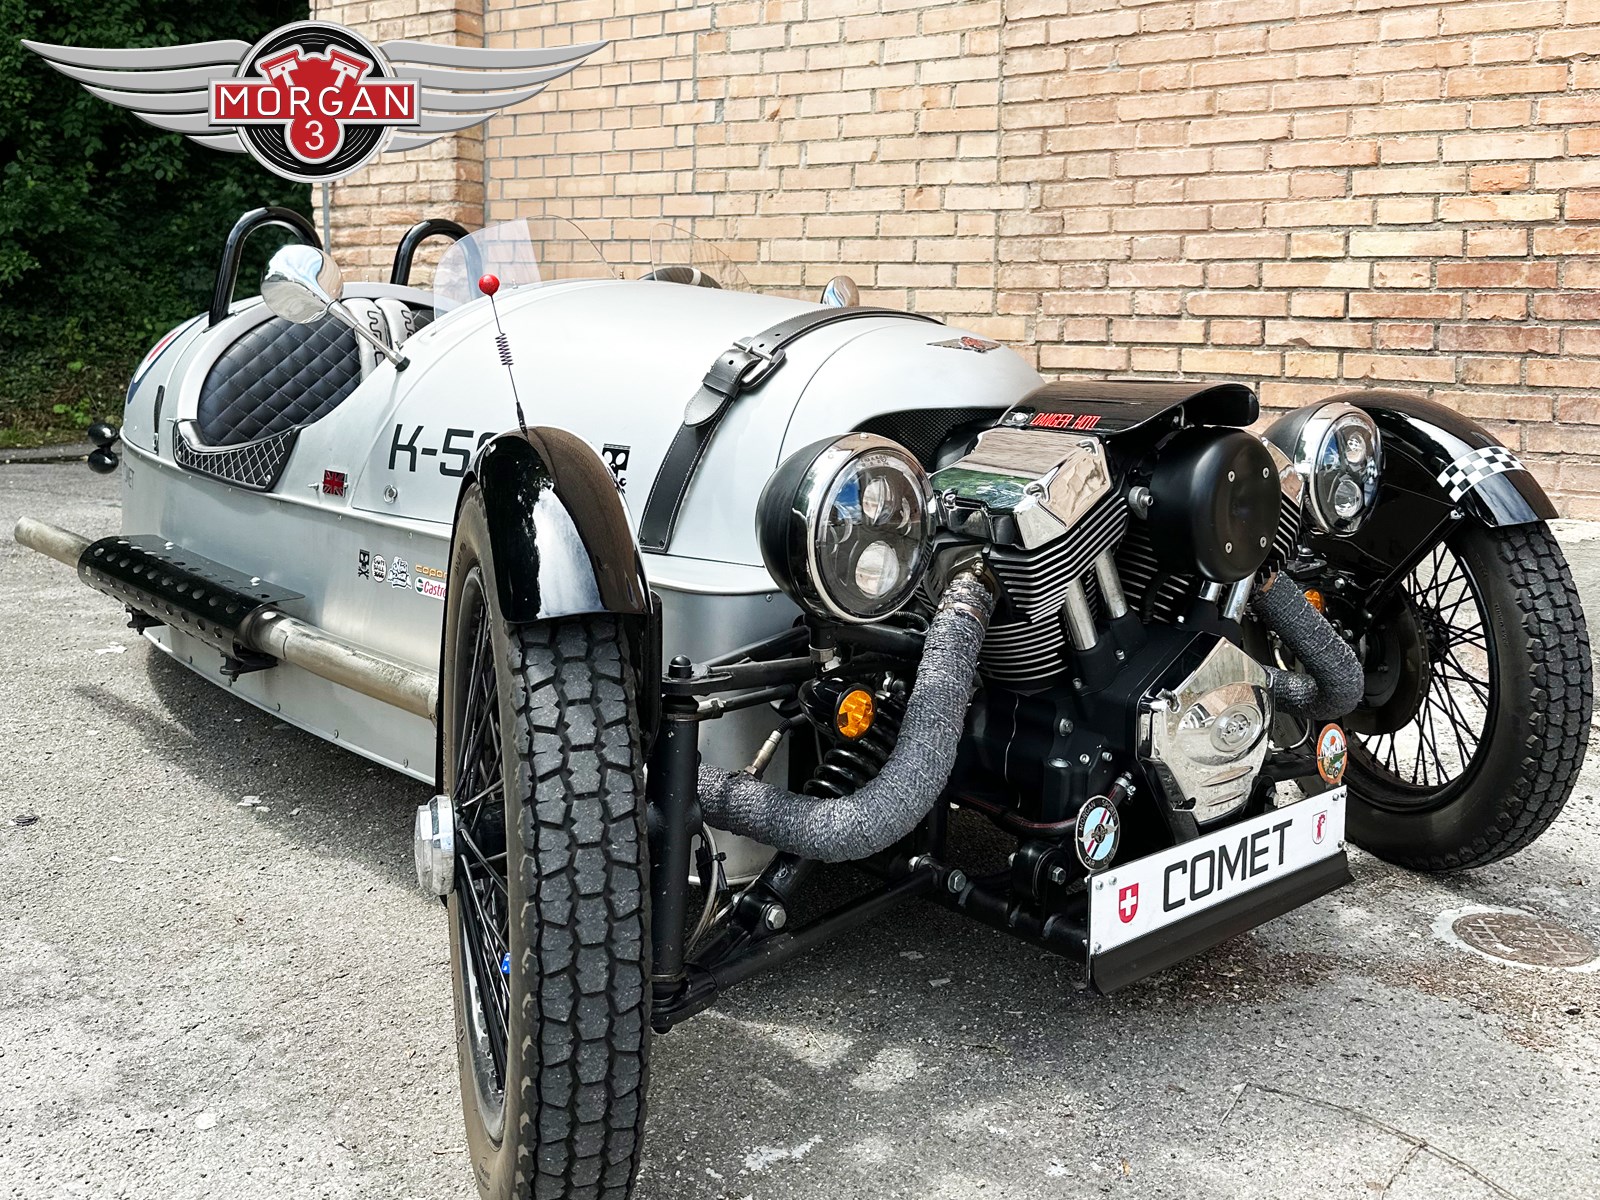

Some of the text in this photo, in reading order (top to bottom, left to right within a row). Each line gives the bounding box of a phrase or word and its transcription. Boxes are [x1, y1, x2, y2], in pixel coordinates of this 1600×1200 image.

[1030, 412, 1075, 429] DANGER
[1078, 802, 1096, 831] MORGAN
[1084, 856, 1096, 868] CAR
[1163, 818, 1294, 913] COMET
